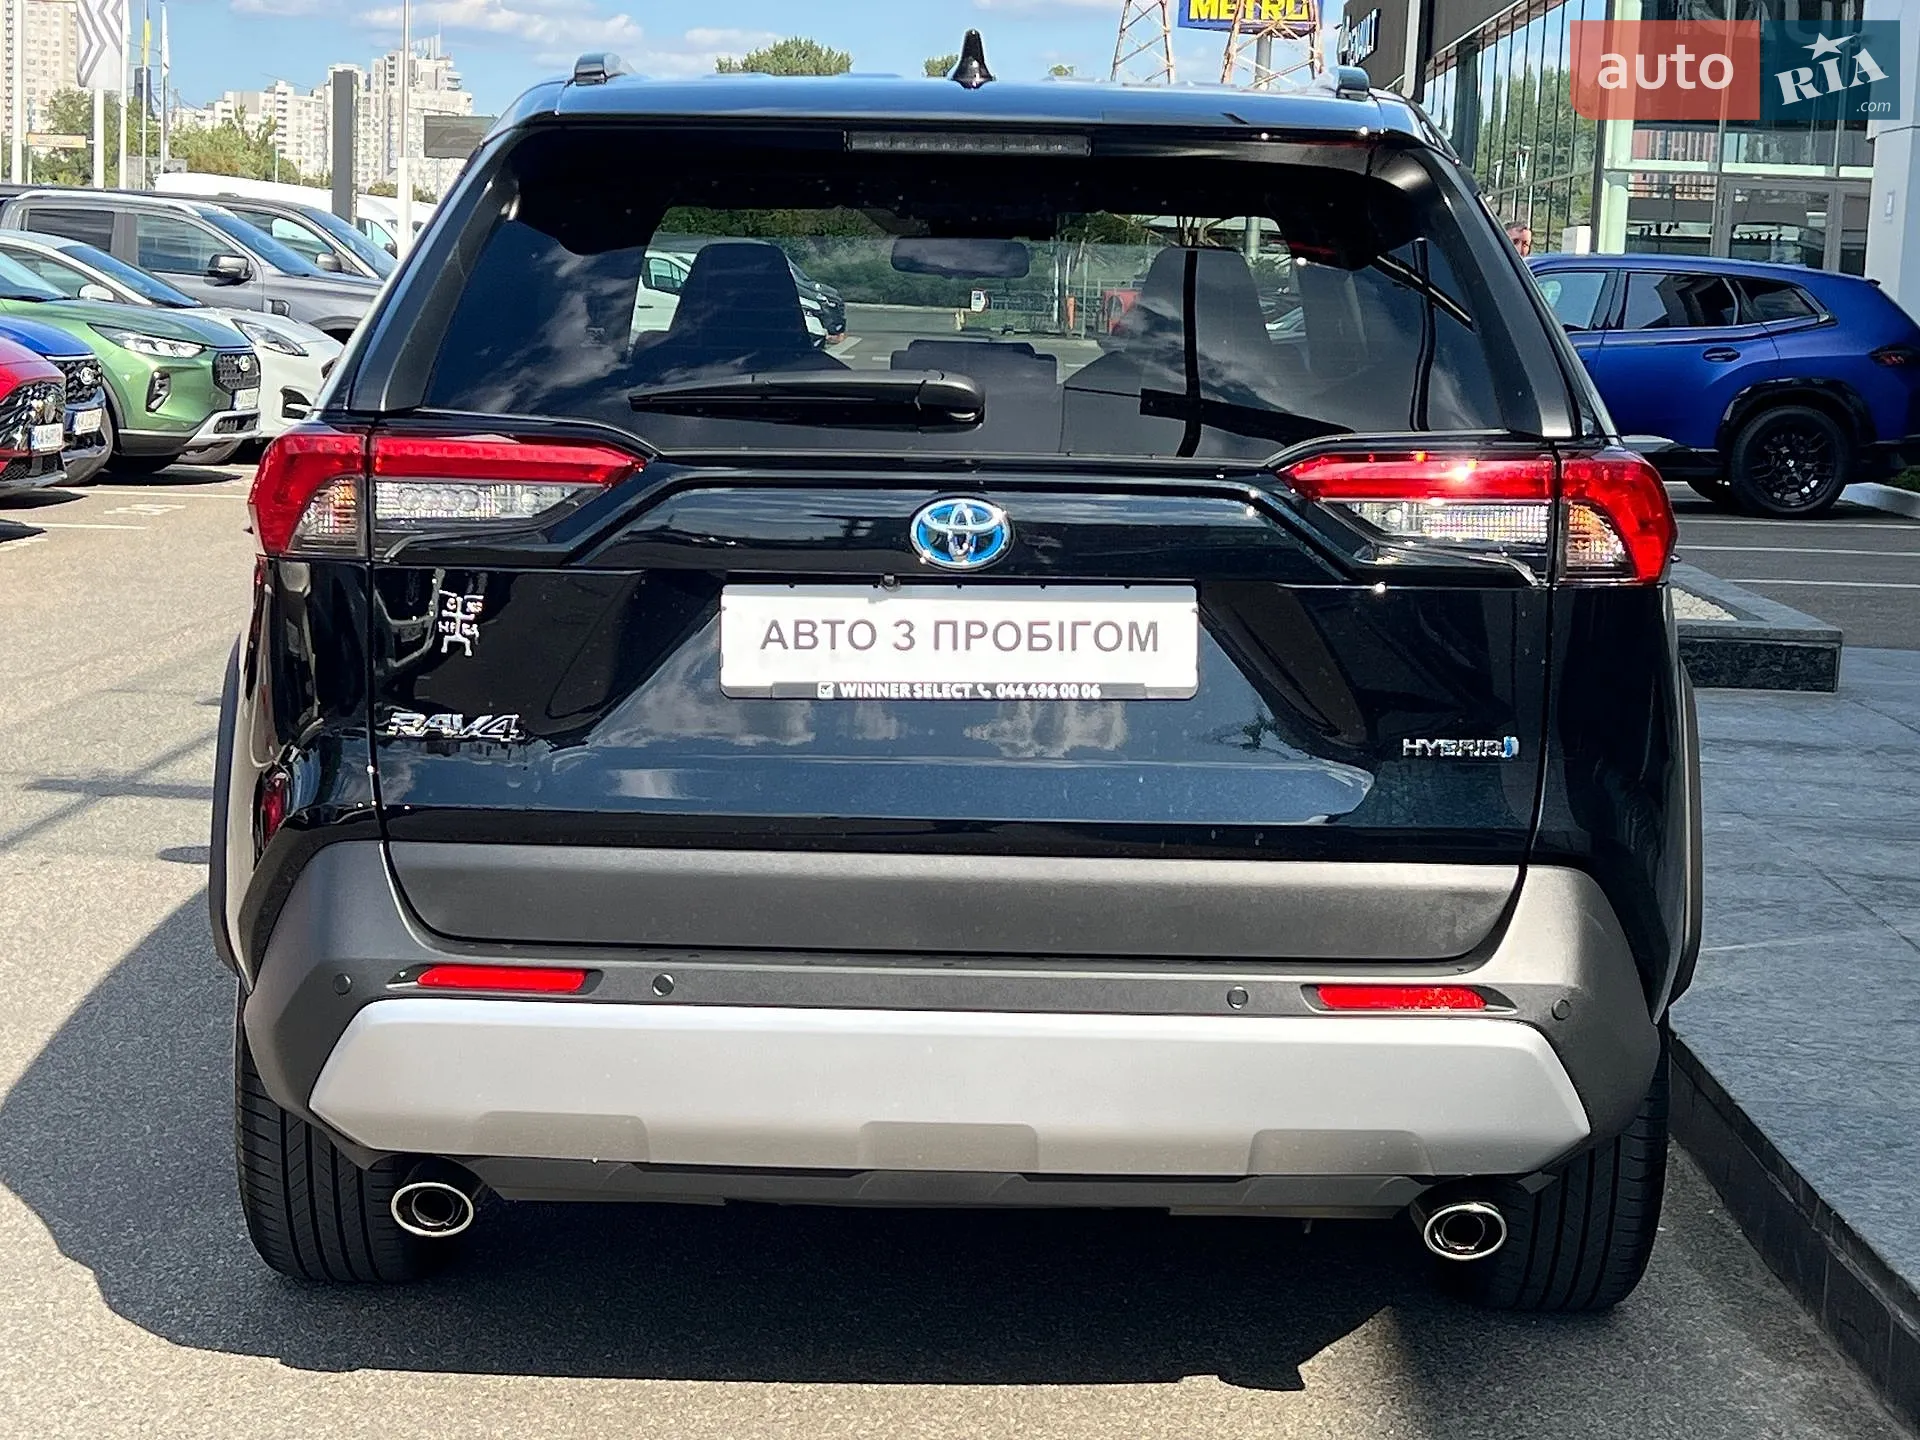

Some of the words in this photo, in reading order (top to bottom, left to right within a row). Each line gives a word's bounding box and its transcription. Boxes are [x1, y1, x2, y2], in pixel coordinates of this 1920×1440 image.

[761, 619, 878, 651] АВТО
[934, 620, 1158, 653] ПРОБІГОМ
[839, 682, 911, 699] WINNER
[914, 683, 973, 699] SELECT
[996, 683, 1026, 699] 044
[1028, 683, 1057, 699] 496
[1059, 683, 1080, 699] 00
[1082, 683, 1101, 699] 06
[387, 712, 521, 742] RAV4
[1402, 738, 1504, 757] HYBRID
